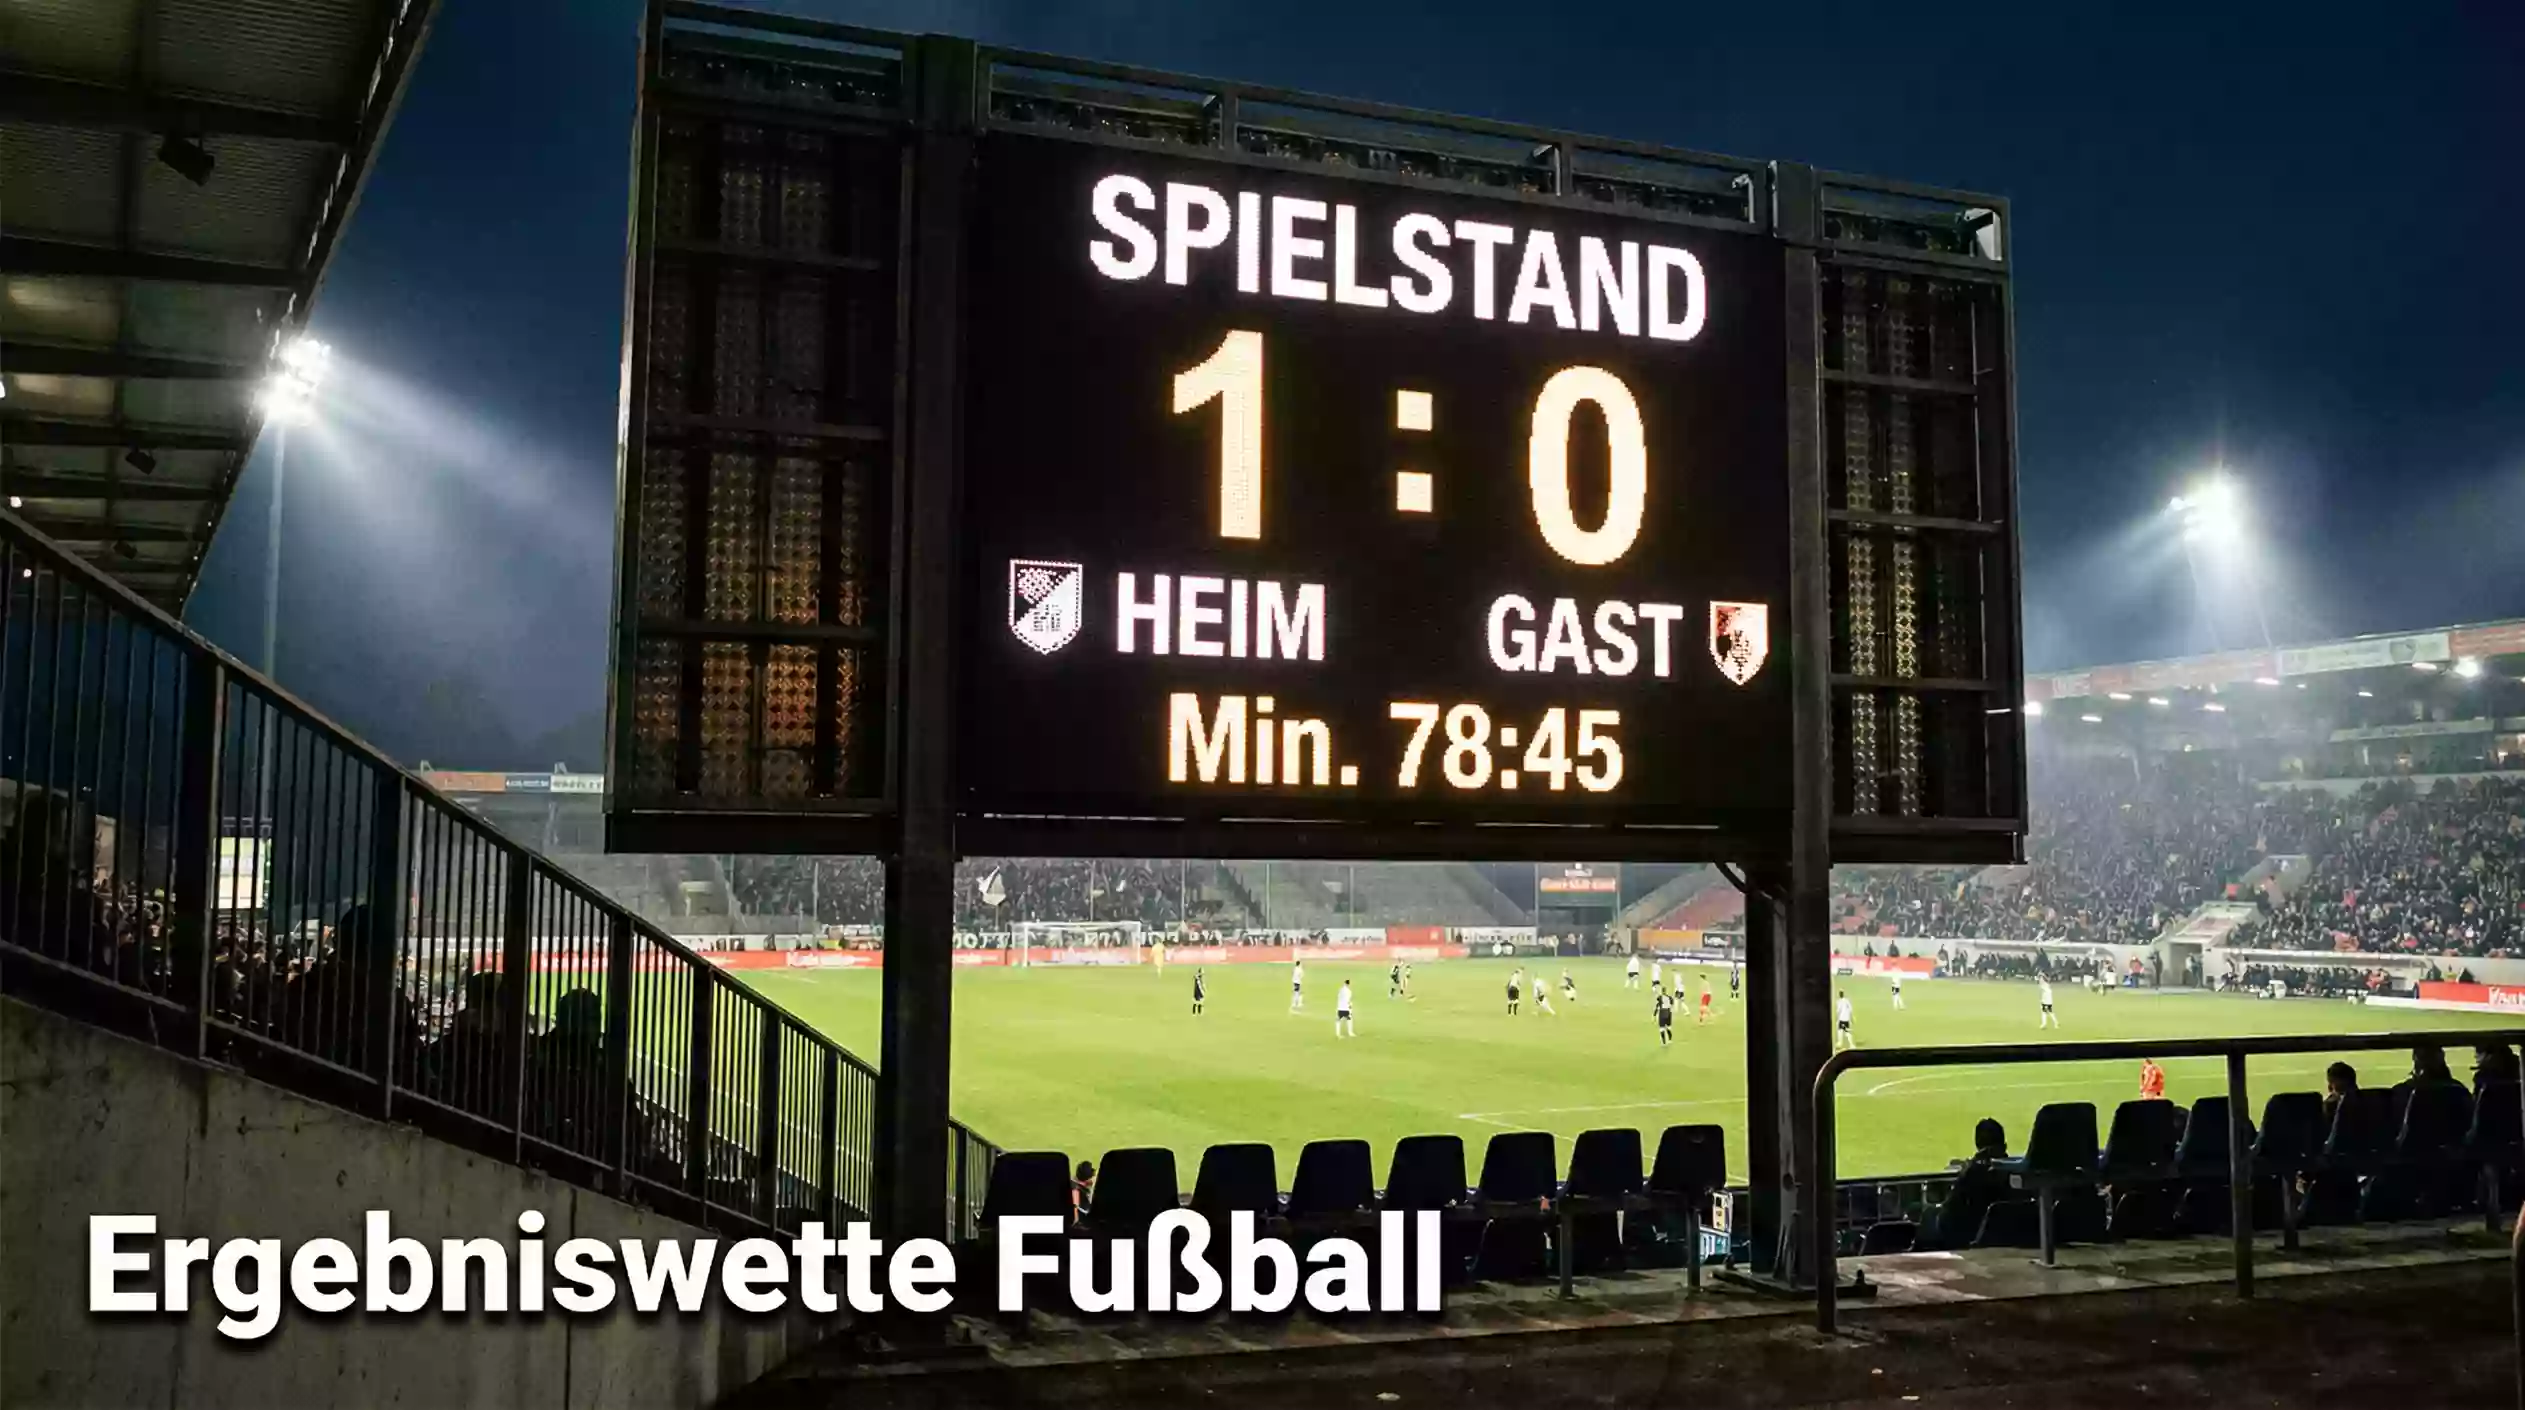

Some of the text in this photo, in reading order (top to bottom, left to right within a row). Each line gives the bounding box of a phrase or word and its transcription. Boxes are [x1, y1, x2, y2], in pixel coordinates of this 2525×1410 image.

[1089, 171, 1708, 343] SPIELSTAND
[1172, 329, 1648, 566] 1 : 0
[1116, 572, 1326, 662] HEIM
[1486, 594, 1684, 678] GAST
[1167, 692, 1624, 793] Min. 78:45
